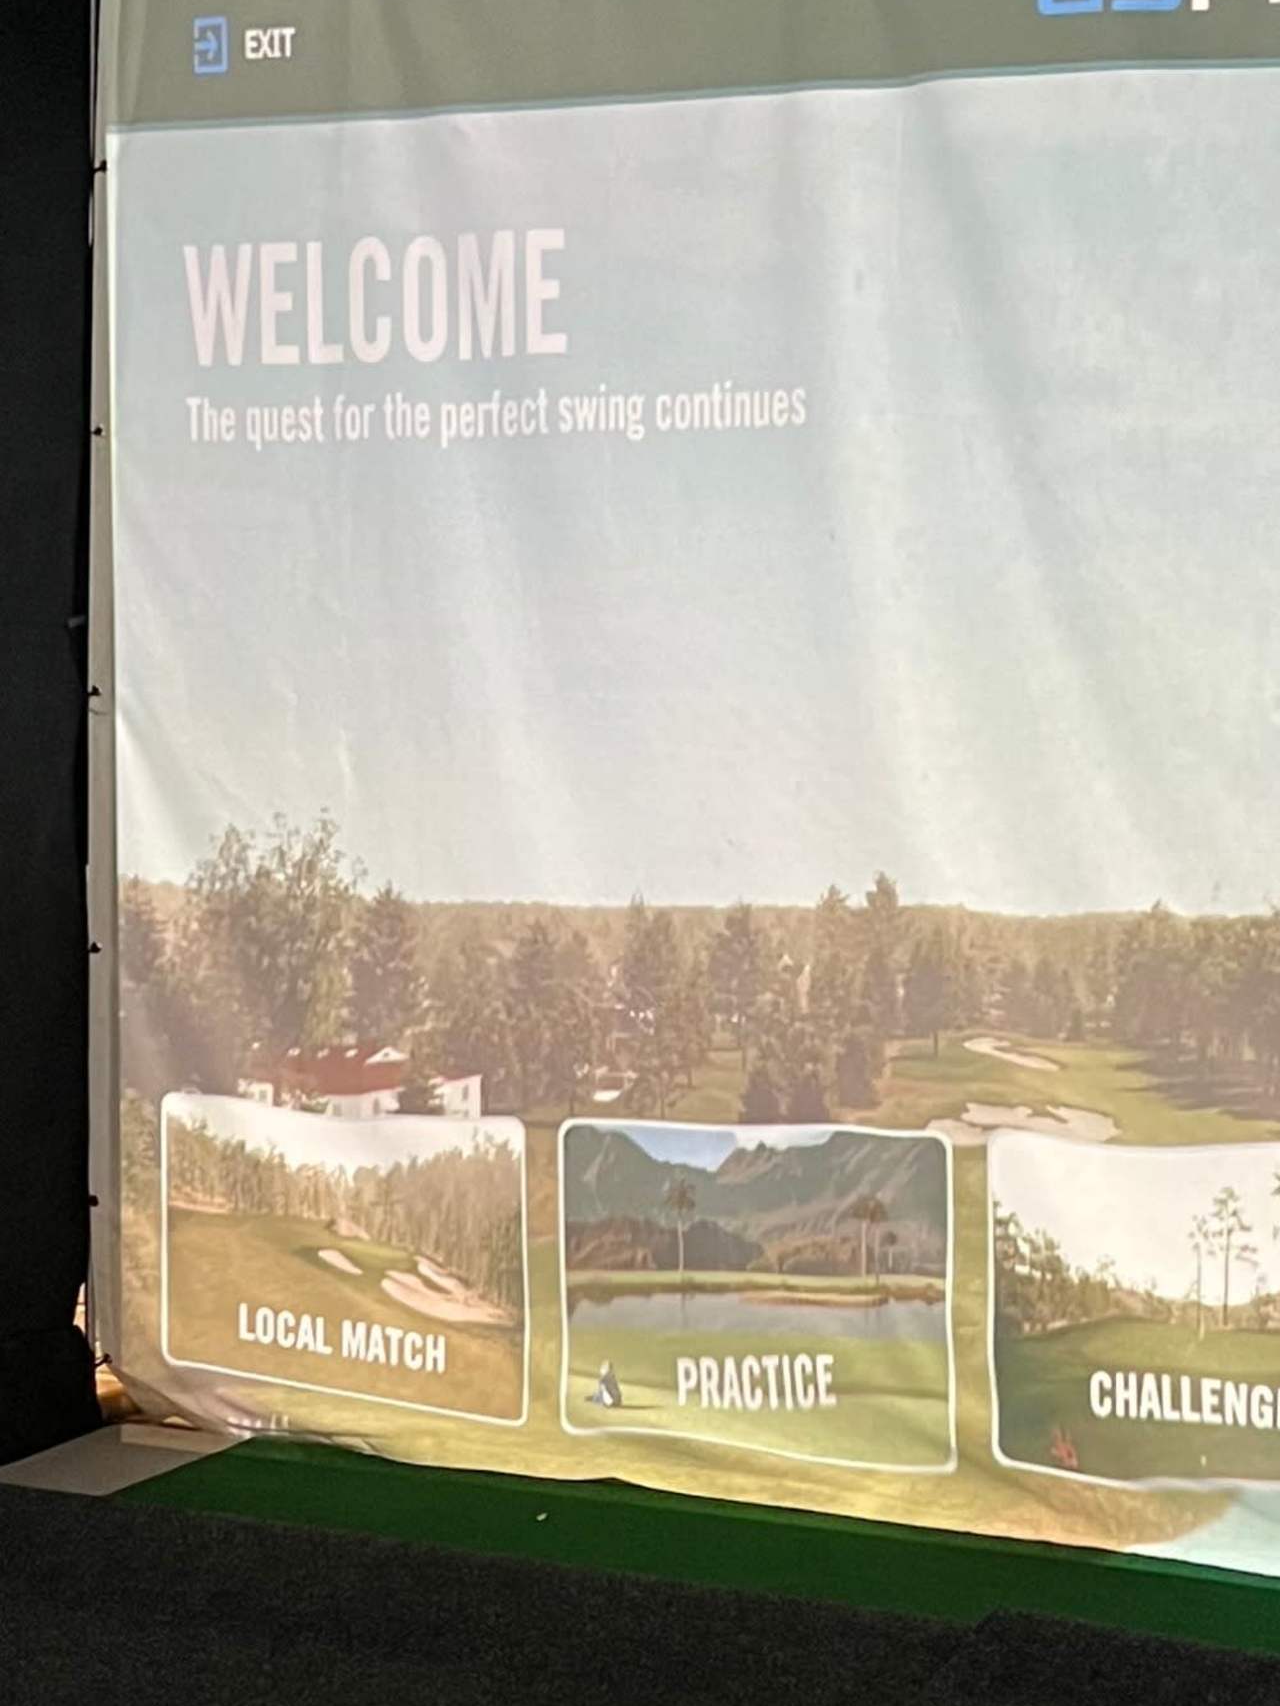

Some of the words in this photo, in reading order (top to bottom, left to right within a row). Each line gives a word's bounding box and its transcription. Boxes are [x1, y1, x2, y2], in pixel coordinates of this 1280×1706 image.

[244, 26, 296, 60] EXIT
[182, 227, 569, 368] WELCOME
[185, 396, 237, 443] The
[245, 395, 325, 452] quest
[332, 393, 376, 442] for
[382, 390, 432, 439] the
[440, 388, 549, 450] perfect
[558, 383, 646, 442] swing
[655, 379, 808, 433] continues
[237, 1302, 333, 1356] LOCAL
[341, 1325, 447, 1374] MATCH
[676, 1353, 838, 1412] PRACTICE
